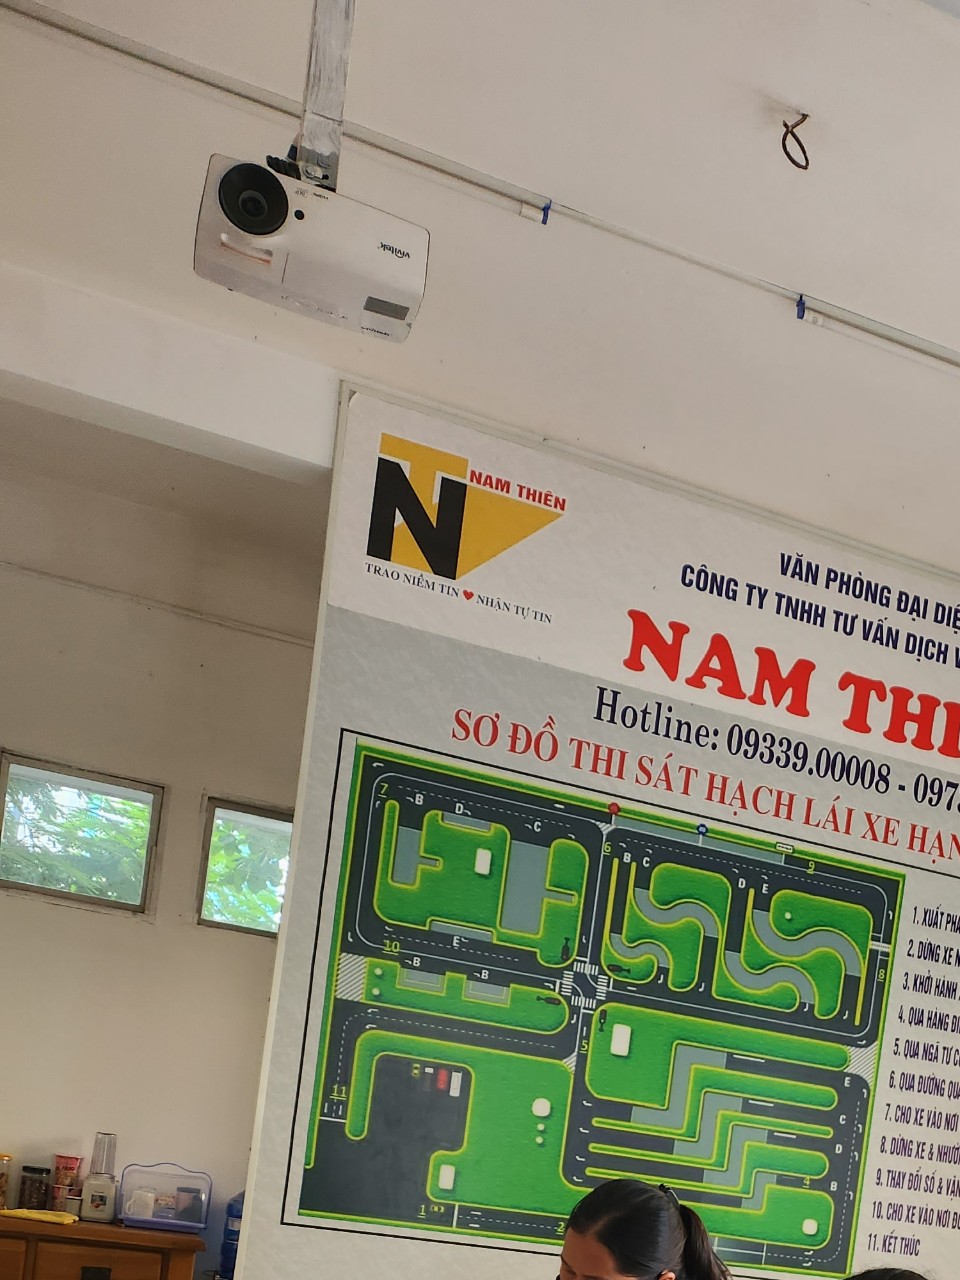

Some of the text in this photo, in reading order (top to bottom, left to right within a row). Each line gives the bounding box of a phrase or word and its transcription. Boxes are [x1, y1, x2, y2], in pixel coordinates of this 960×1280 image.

[469, 469, 566, 512] NAM THIÊN
[364, 562, 401, 581] TRAO
[438, 583, 460, 598] TIN
[476, 594, 510, 613] NHẬN
[533, 610, 551, 624] TIN
[780, 551, 820, 587] VĂN
[824, 567, 892, 609] PHÒNG
[895, 589, 929, 623] ĐẠI
[680, 563, 739, 602] CÔNG
[745, 582, 769, 610] TY
[774, 591, 827, 629] TNHH
[832, 608, 859, 637] TƯ
[862, 617, 900, 651] VẤN
[903, 631, 950, 665] DỊCH
[623, 608, 817, 719] NAM
[592, 685, 720, 751] Hotline:
[726, 723, 891, 795] 09339.00008
[380, 783, 389, 795] 7
[451, 709, 501, 747] SƠ
[508, 715, 560, 763] ĐỒ
[567, 737, 628, 781] THI
[634, 751, 699, 797] SÁT
[704, 771, 796, 822] HẠCH
[802, 796, 855, 836] LÁI
[860, 811, 901, 847] XE
[912, 905, 920, 926] 1.
[921, 906, 946, 930] XUẤT
[906, 938, 915, 959] 2.
[916, 937, 941, 964] DỪNG
[941, 945, 955, 966] XE
[902, 971, 910, 991] 3.
[911, 970, 934, 996] KHỞI
[933, 974, 959, 1001] HÀNH
[897, 1004, 906, 1024] 4.
[907, 1006, 925, 1028] QUA
[925, 1006, 950, 1033] HÀNG
[892, 1037, 901, 1057] 5.
[903, 1038, 920, 1061] QUA
[941, 1045, 954, 1066] TƯ
[888, 1069, 896, 1089] 6.
[898, 1071, 916, 1093] QUA
[916, 1072, 946, 1098] ĐƯỜNG
[884, 1102, 892, 1122] 7.
[894, 1104, 912, 1125] CHO
[912, 1107, 925, 1127] XE
[926, 1106, 943, 1130] VÀO
[943, 1112, 960, 1133] NƠI
[879, 1135, 888, 1155] 8.
[889, 1133, 914, 1158] DỪNG
[913, 1140, 927, 1160] XE
[927, 1142, 935, 1161] &
[875, 1167, 883, 1187] 9.
[885, 1169, 907, 1190] THAY
[907, 1167, 923, 1192] ĐỔI
[923, 1169, 937, 1194] SỐ
[936, 1177, 944, 1195] &
[872, 1200, 884, 1220] 10.
[885, 1202, 904, 1222] CHO
[904, 1204, 917, 1224] XE
[918, 1203, 935, 1227] VÀO
[935, 1208, 951, 1229] NƠI
[867, 1229, 921, 1257] 11. KẾT THÚC
